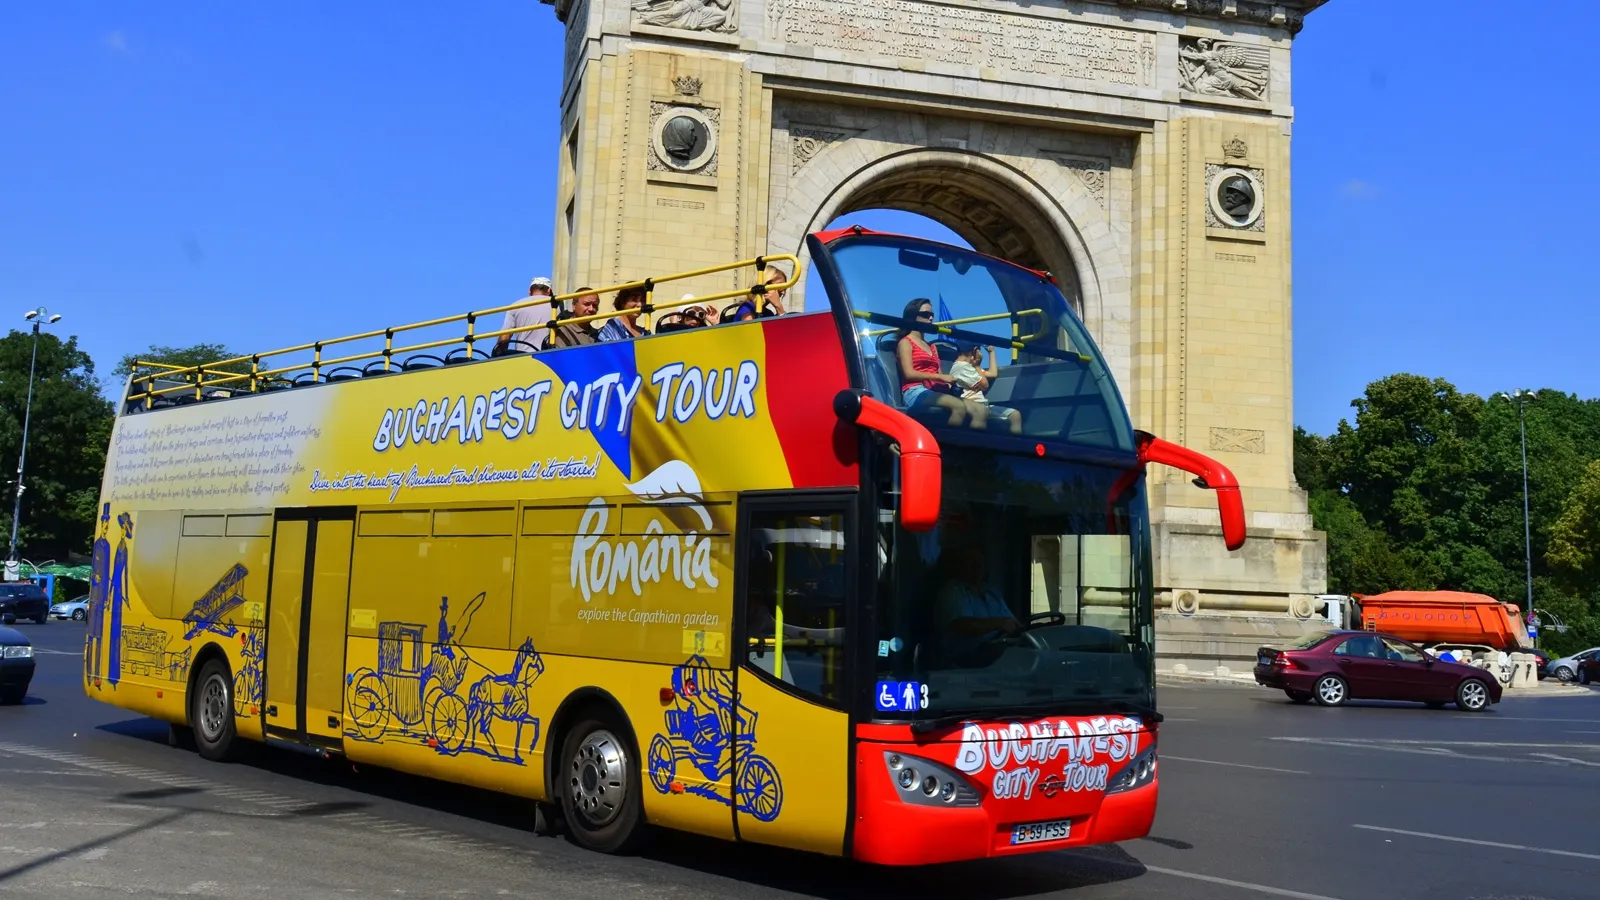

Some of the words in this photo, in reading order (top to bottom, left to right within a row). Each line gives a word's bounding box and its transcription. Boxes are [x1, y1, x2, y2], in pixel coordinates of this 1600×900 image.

[373, 380, 552, 452] BUCHAREST
[560, 372, 642, 437] CITY
[652, 360, 758, 423] TOUR
[309, 469, 330, 491] Dive
[331, 471, 349, 489] into
[351, 470, 366, 488] the
[367, 470, 392, 489] heart
[389, 470, 405, 502] of
[405, 463, 457, 488] Bucharest
[455, 466, 478, 484] and
[477, 463, 518, 484] discover
[521, 461, 541, 480] all
[540, 458, 557, 479] its
[577, 608, 611, 624] explore
[612, 608, 627, 622] the
[628, 608, 681, 626] Carpathian
[682, 611, 719, 629] garden
[920, 683, 929, 709] 3
[955, 716, 1143, 775] BUCHAREST
[993, 766, 1040, 800] CITY
[1063, 762, 1109, 792] TOUR
[1018, 825, 1027, 841] B
[1029, 823, 1043, 839] 59
[1044, 821, 1068, 838] FSS
